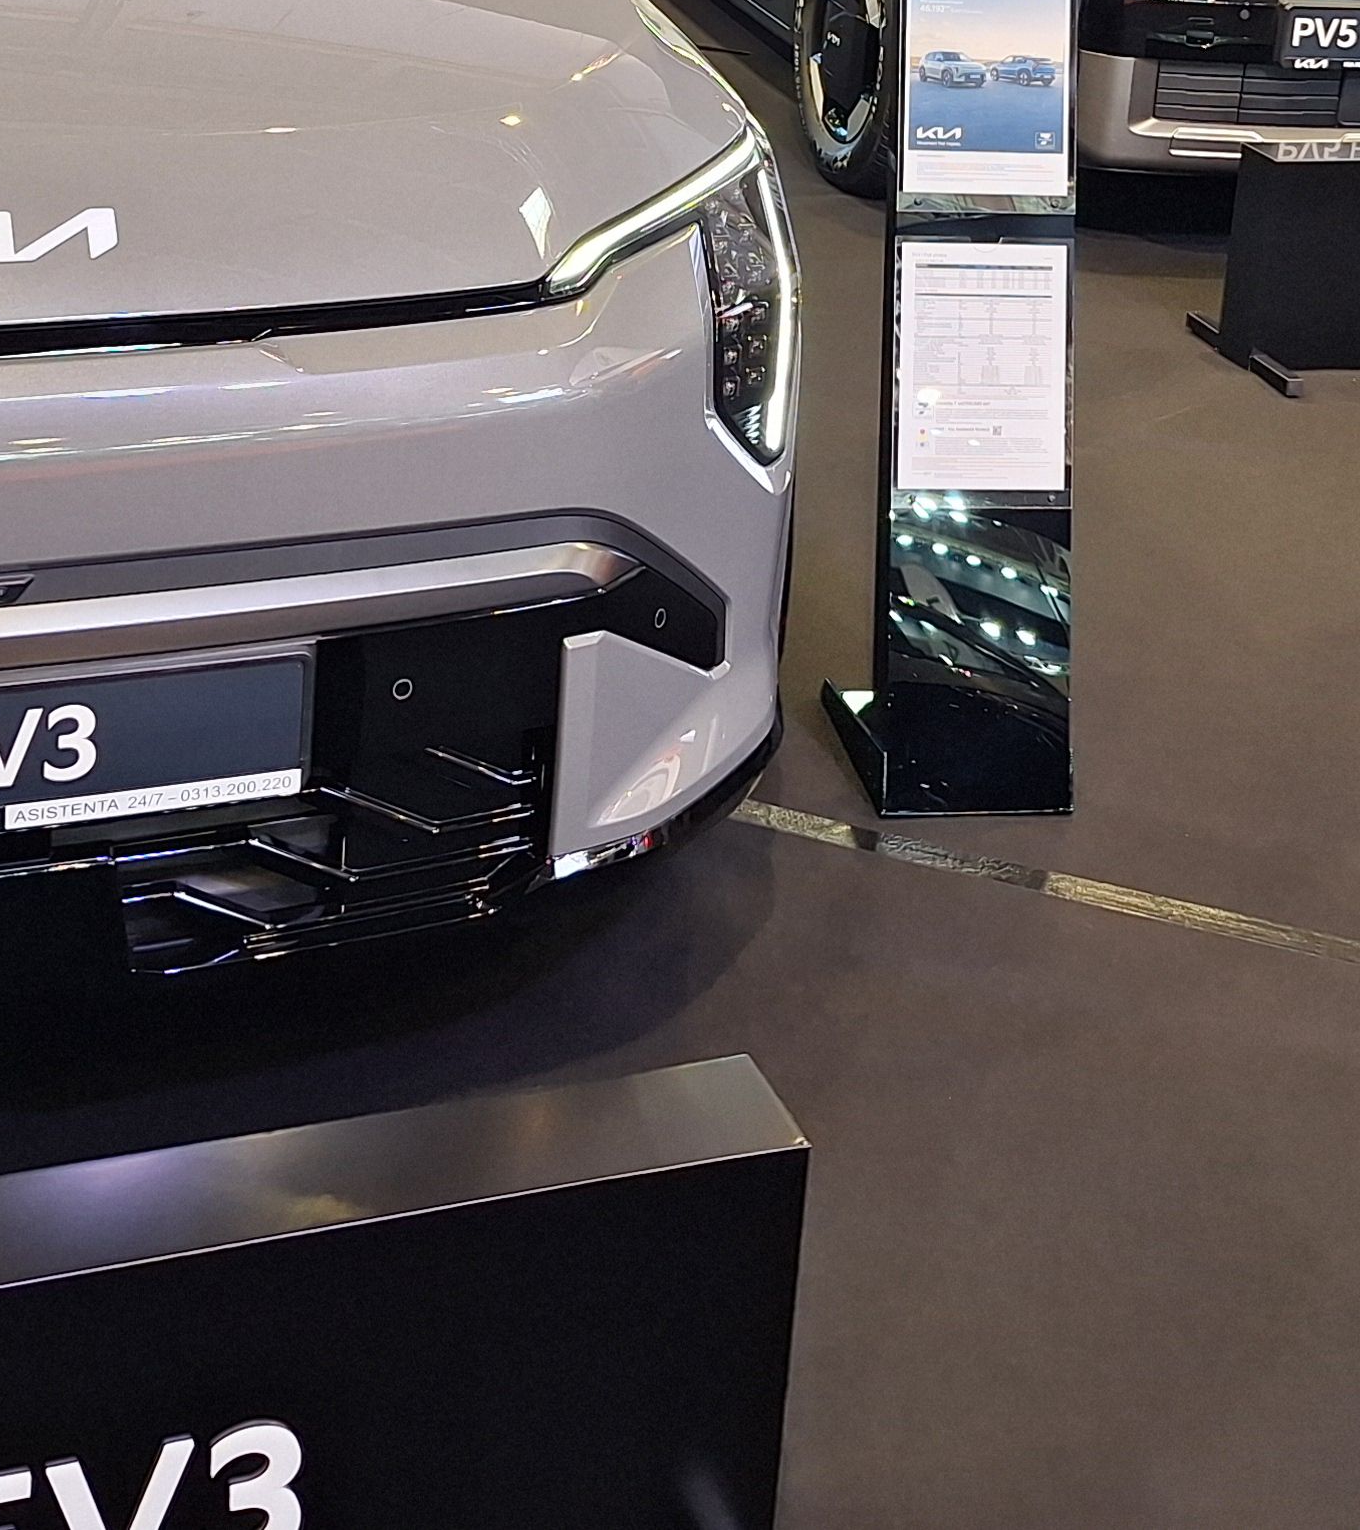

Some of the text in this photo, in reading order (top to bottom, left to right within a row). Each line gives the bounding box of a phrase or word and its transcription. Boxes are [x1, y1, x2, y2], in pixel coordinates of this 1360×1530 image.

[1291, 17, 1358, 48] PV5
[13, 797, 120, 823] ASISTENTA
[126, 792, 164, 810] 24/7
[180, 775, 292, 804] 0313.200.220
